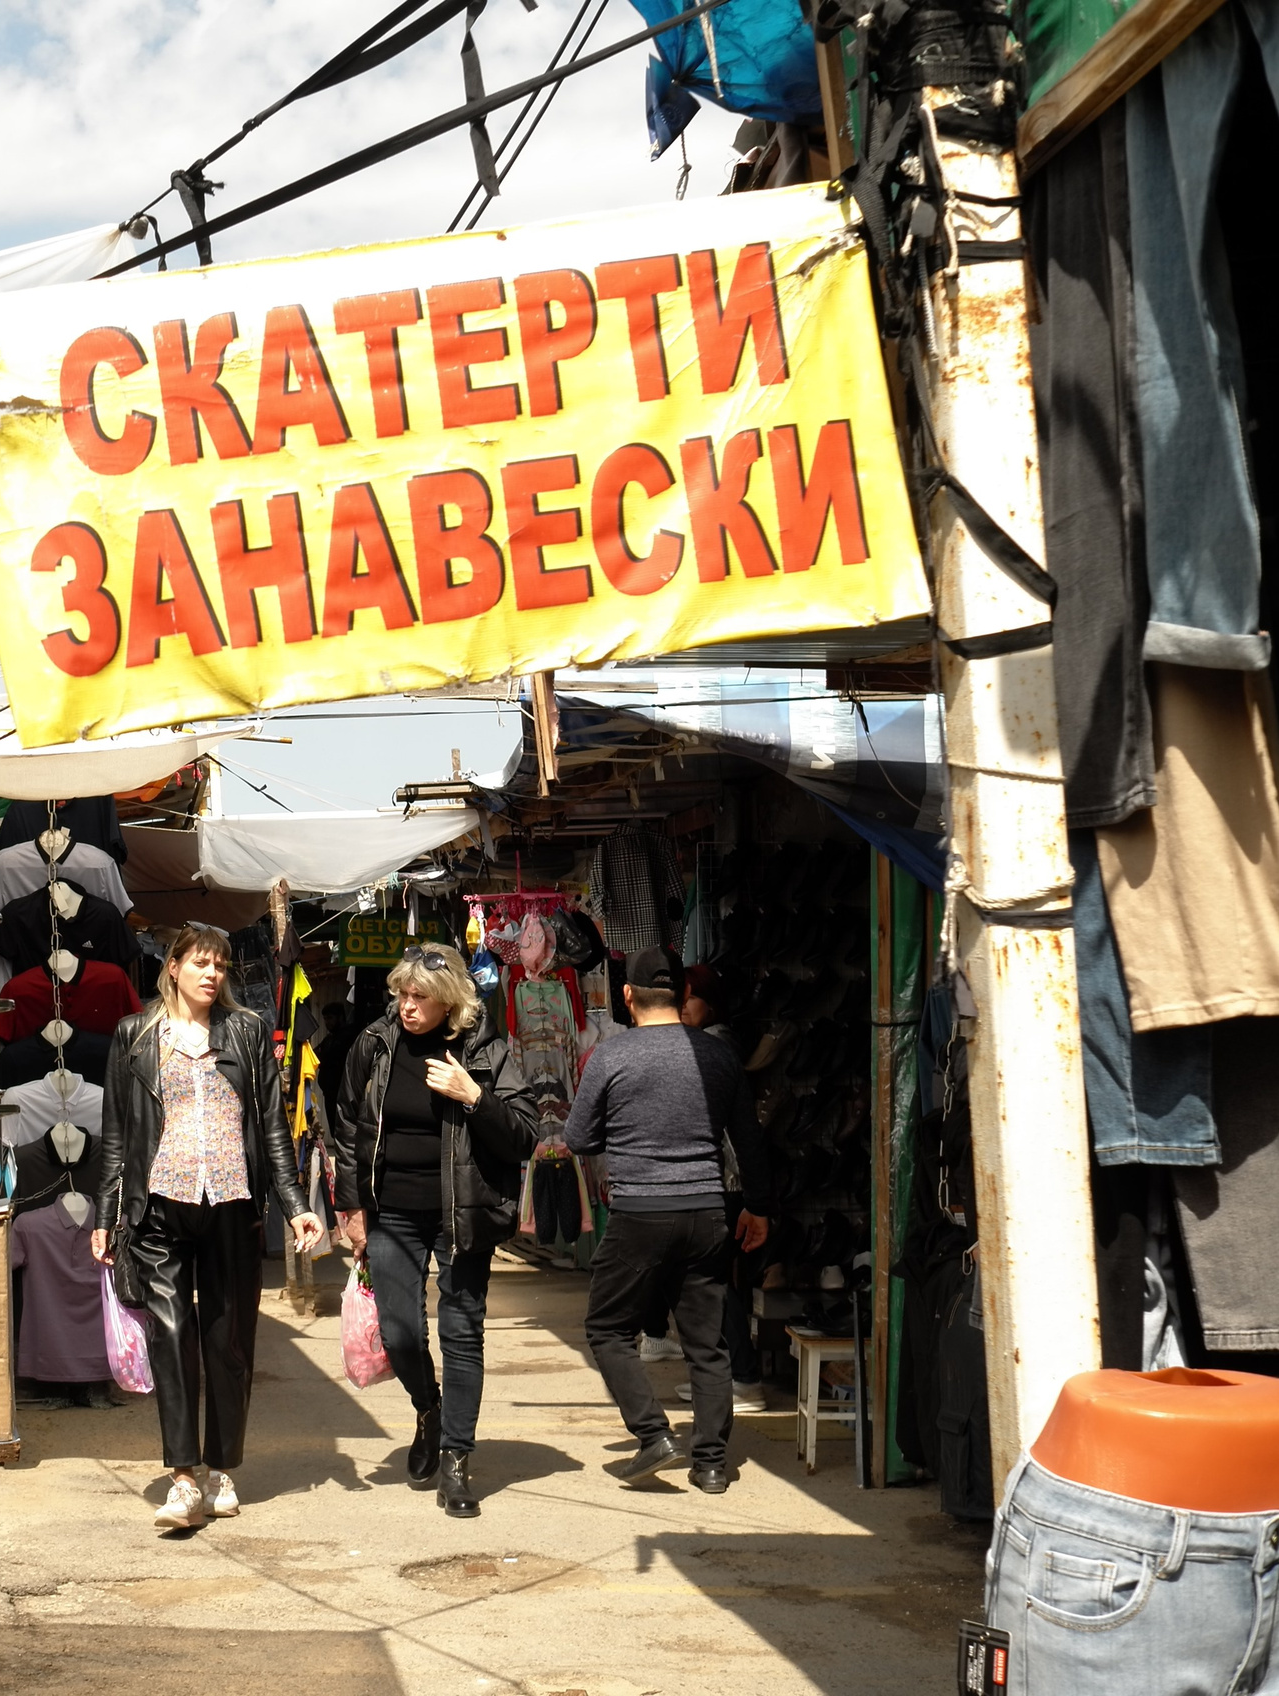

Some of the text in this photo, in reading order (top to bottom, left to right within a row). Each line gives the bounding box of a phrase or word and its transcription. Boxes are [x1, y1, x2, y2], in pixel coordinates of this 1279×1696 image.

[59, 241, 790, 476] СКАТЕРТИ
[30, 420, 871, 677] ЗАНАВЕСКИ
[345, 935, 430, 955] ОБУВ
